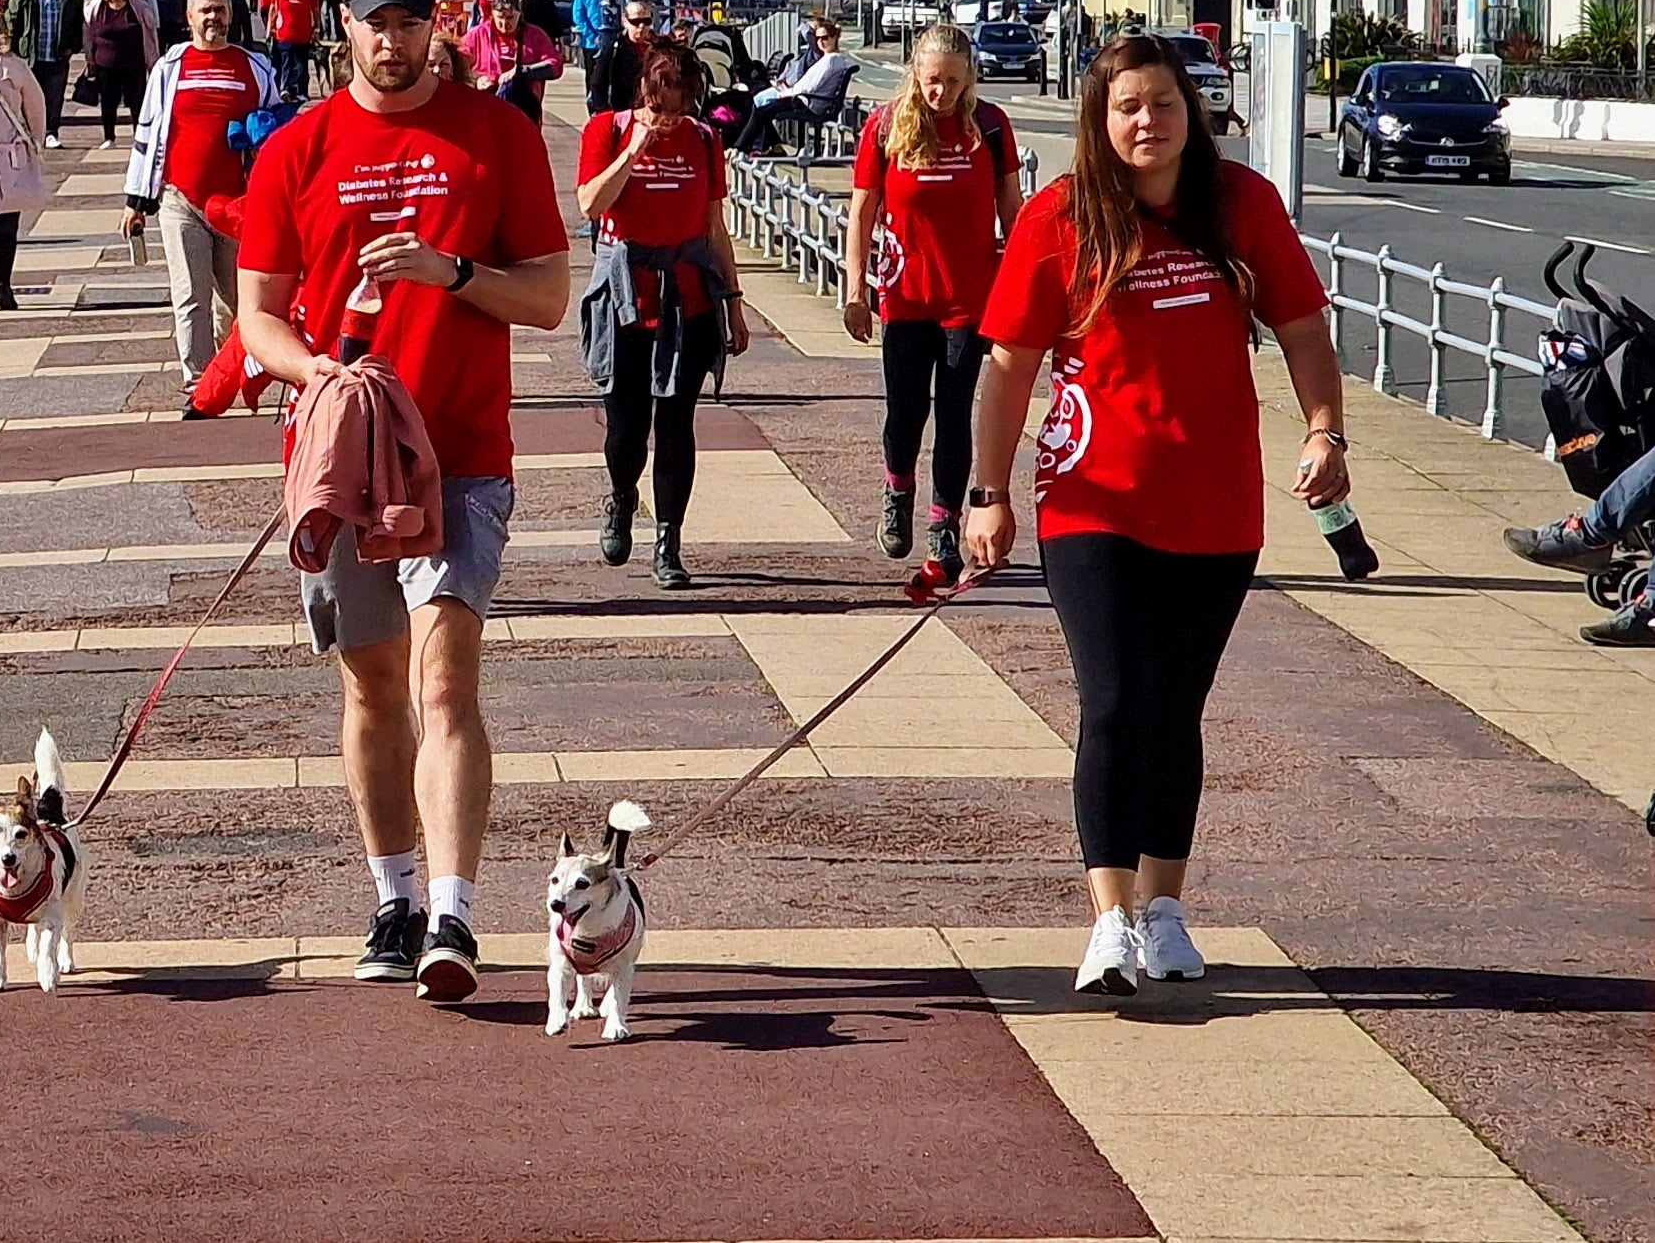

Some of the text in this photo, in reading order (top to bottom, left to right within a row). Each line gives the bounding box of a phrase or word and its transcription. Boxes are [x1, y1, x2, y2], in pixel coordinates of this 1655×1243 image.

[337, 171, 448, 192] Diabetes Research &
[339, 186, 448, 205] Wellness Foundation
